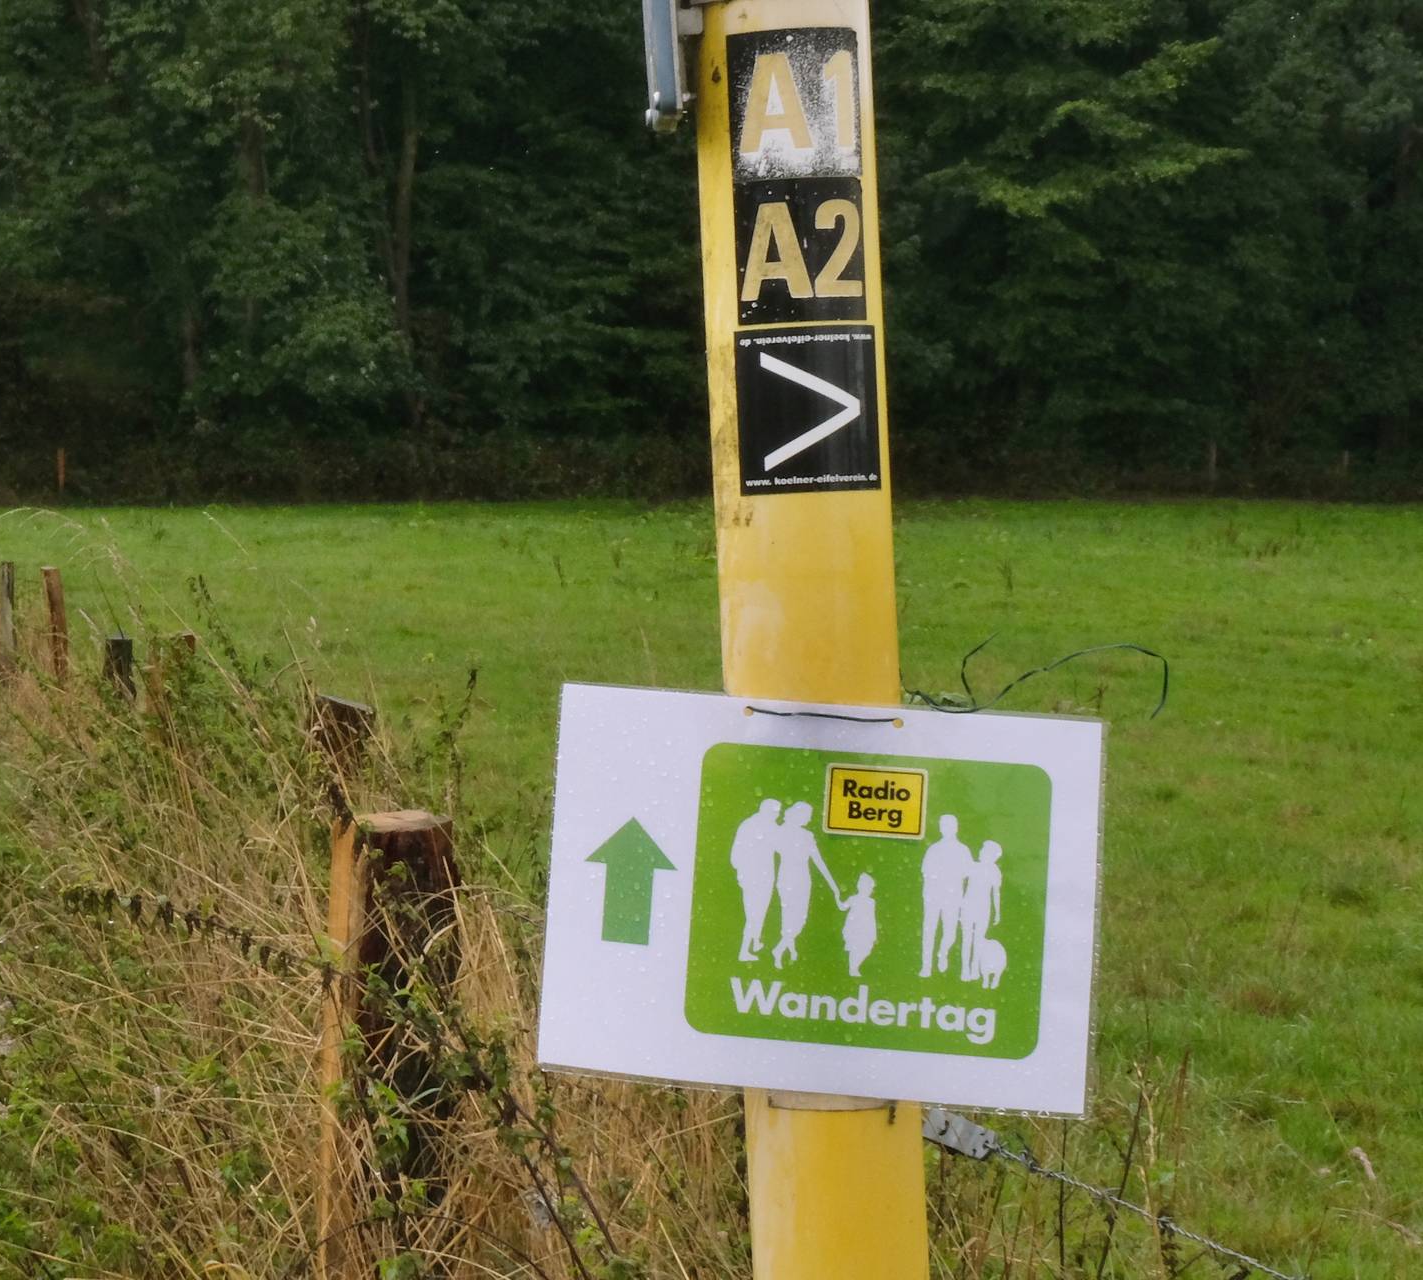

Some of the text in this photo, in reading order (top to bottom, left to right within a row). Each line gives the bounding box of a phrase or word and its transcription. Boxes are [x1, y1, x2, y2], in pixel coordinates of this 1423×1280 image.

[739, 50, 856, 154] A1
[740, 199, 863, 301] A2
[745, 479, 772, 487] www.
[842, 778, 911, 801] Radio
[848, 800, 903, 828] Berg
[730, 976, 996, 1045] Wandertag
